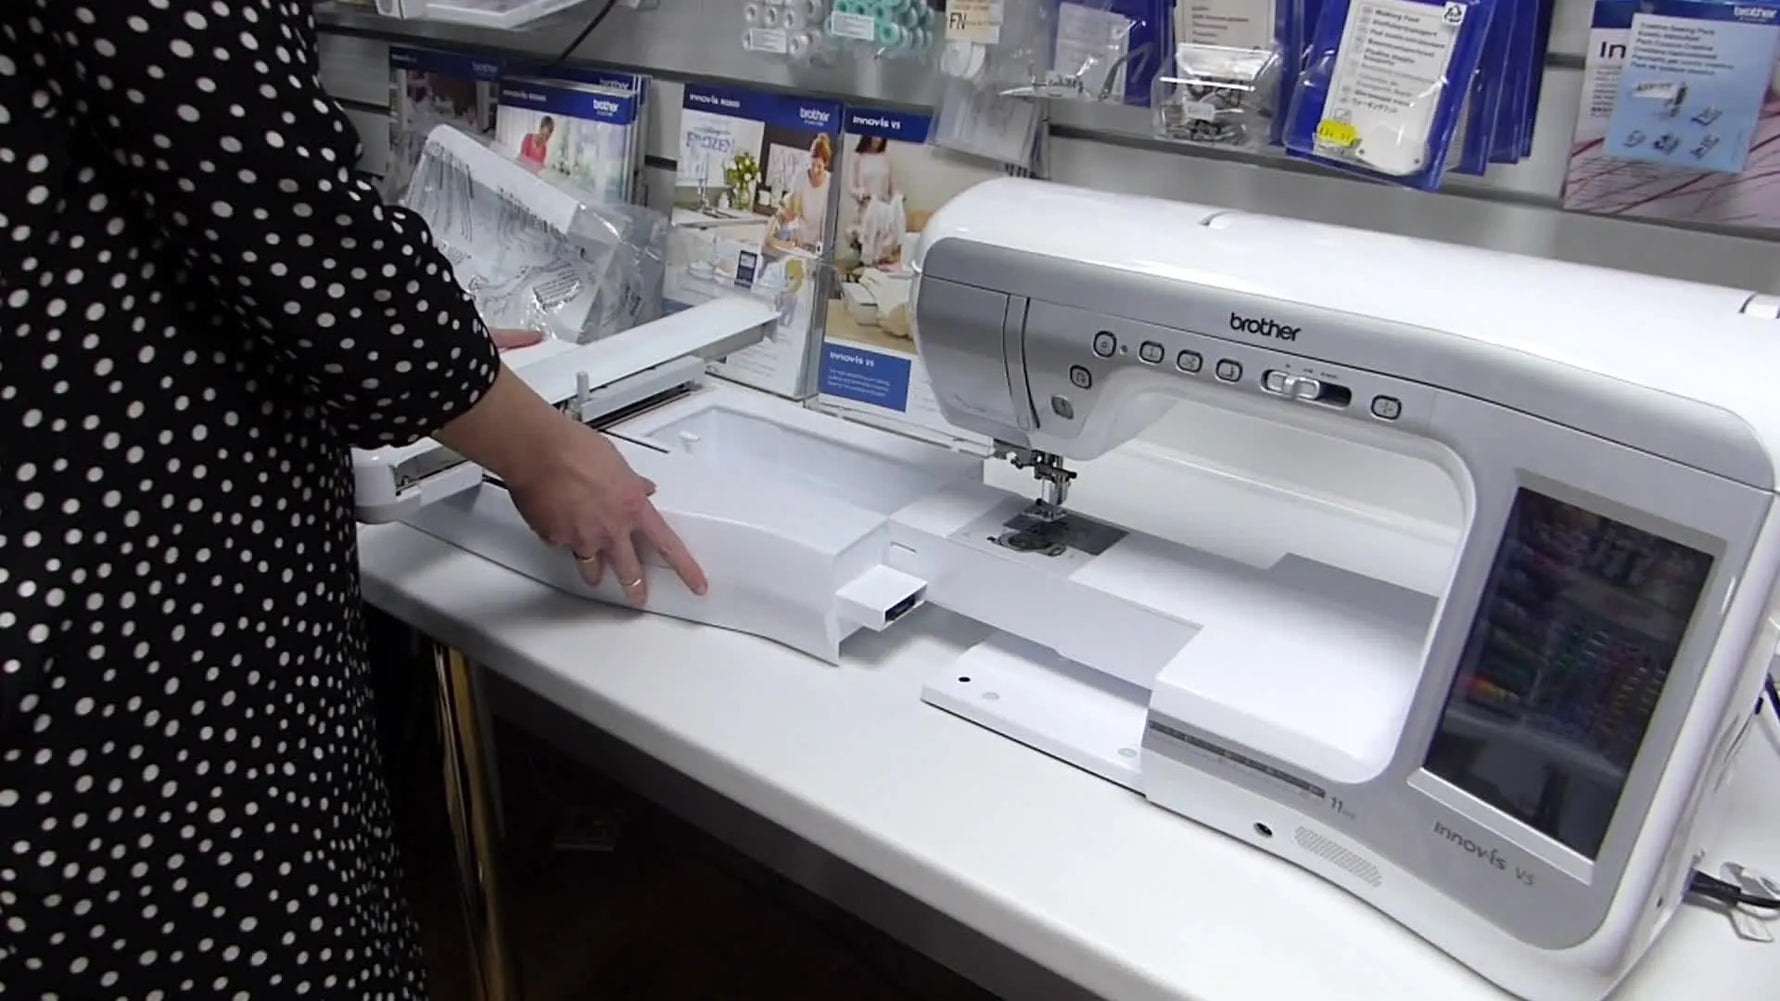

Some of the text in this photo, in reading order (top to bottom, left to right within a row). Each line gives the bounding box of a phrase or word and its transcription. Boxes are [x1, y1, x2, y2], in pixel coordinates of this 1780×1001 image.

[1734, 6, 1777, 19] brother
[800, 106, 831, 122] brother
[1230, 312, 1301, 341] brother
